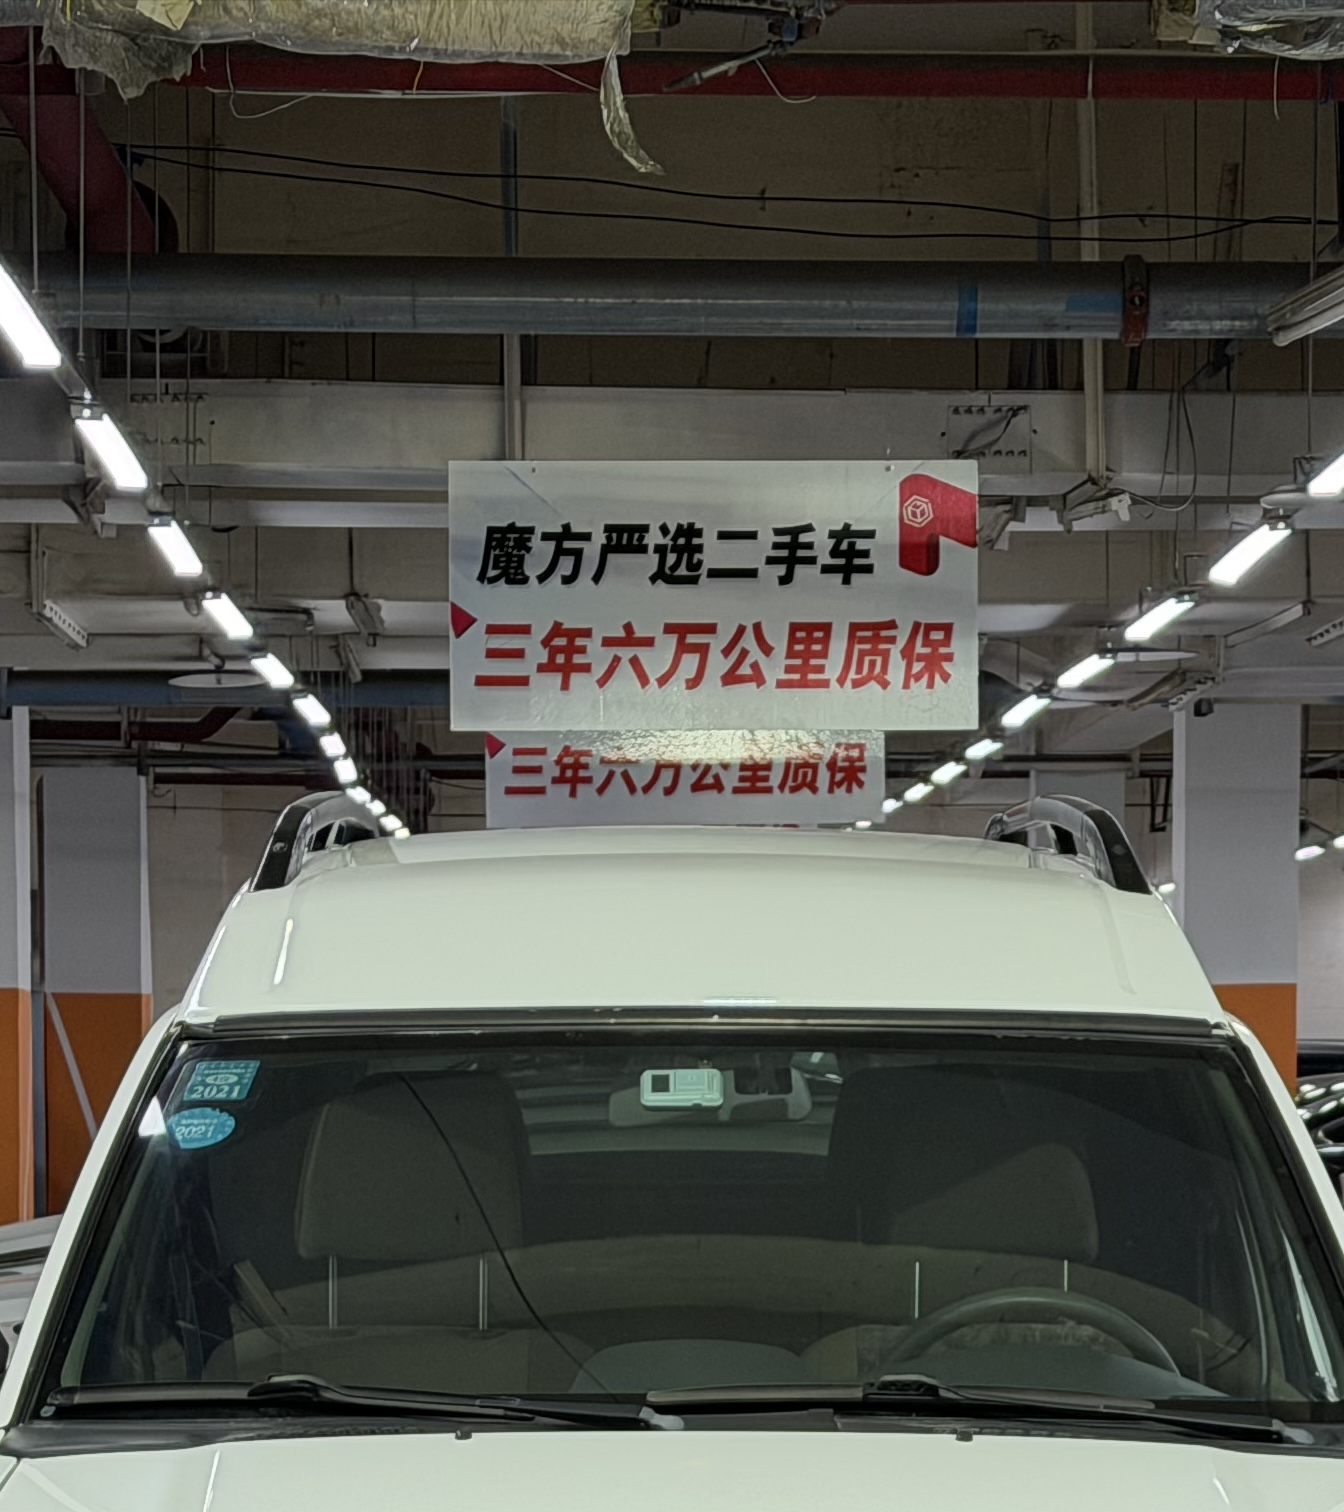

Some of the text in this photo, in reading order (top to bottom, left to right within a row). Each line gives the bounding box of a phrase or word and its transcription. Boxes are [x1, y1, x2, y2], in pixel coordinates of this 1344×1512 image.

[476, 521, 877, 586] 魔方严选二手车
[473, 619, 955, 692] 三年六万公里质保
[190, 1085, 241, 1099] 2021
[175, 1125, 216, 1139] 2021
